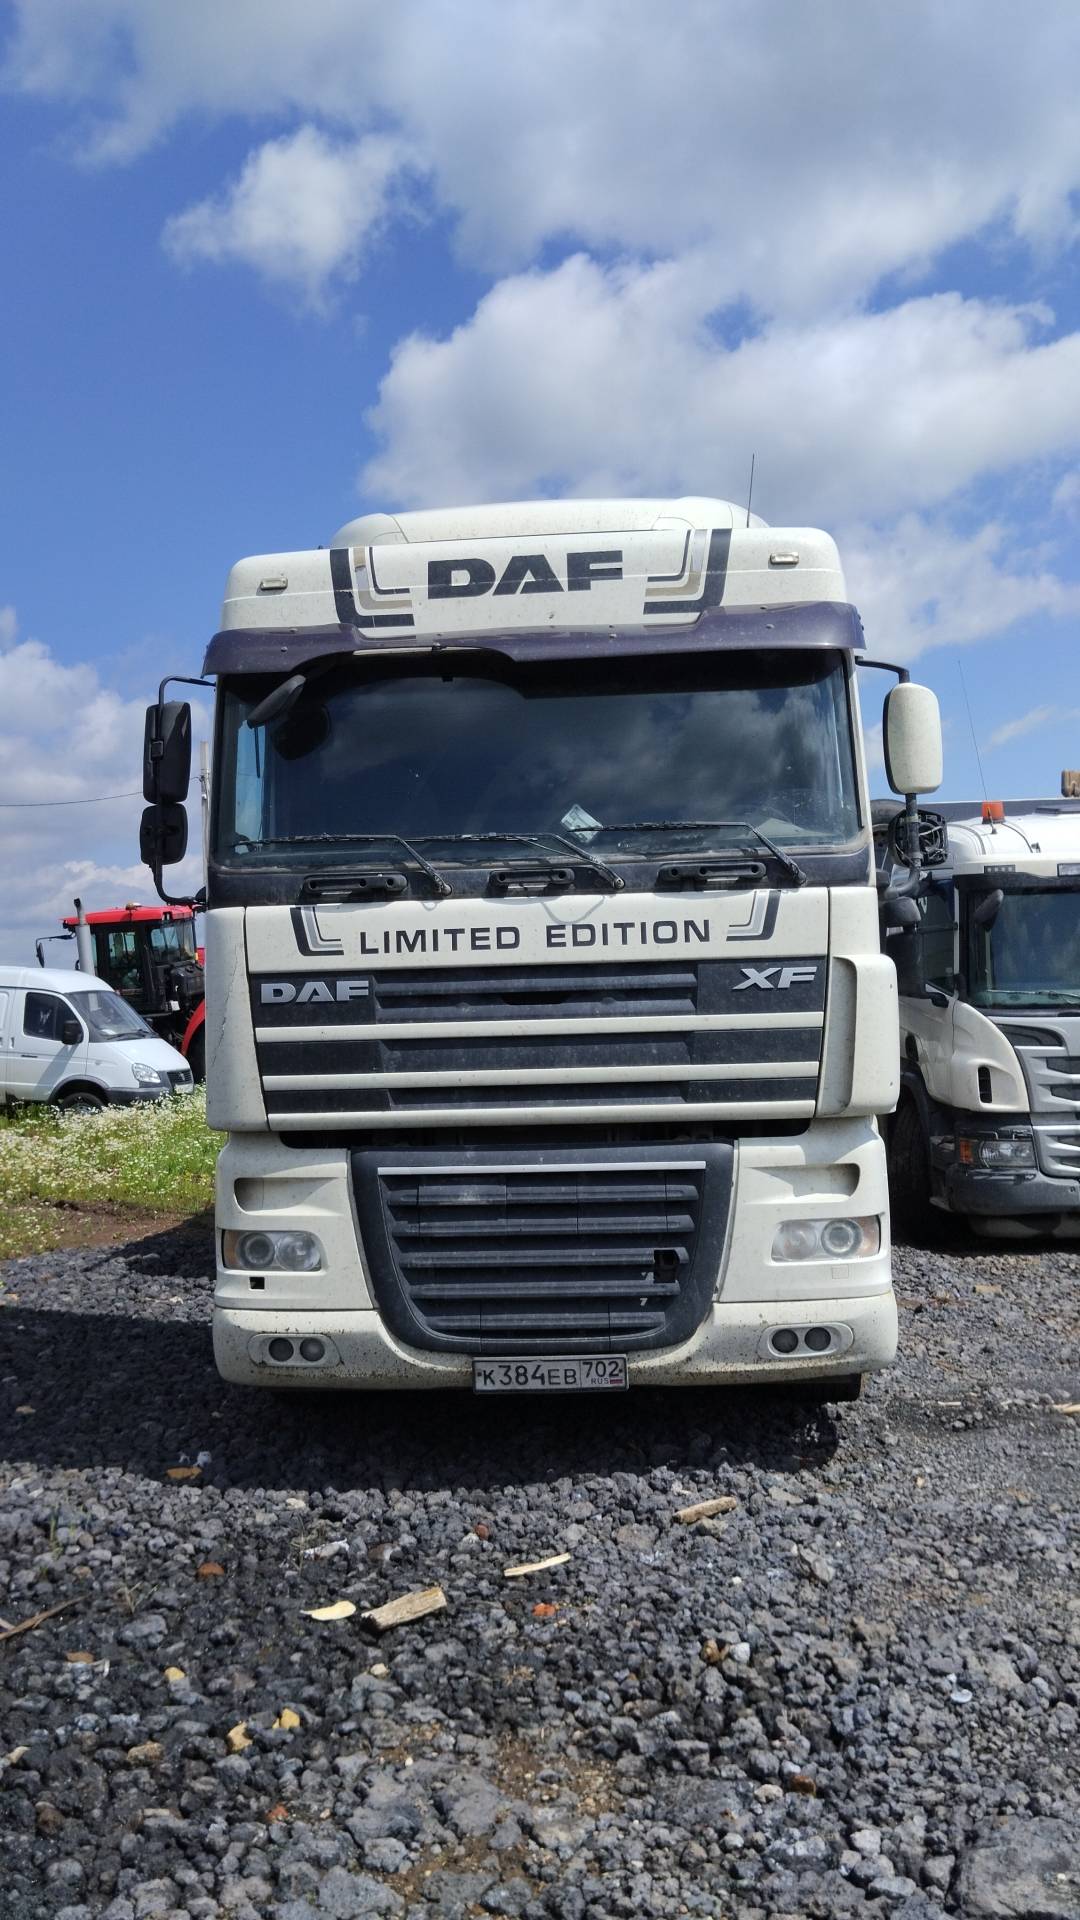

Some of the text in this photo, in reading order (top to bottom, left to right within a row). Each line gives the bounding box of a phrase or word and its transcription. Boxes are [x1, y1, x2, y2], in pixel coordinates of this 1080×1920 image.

[427, 550, 623, 600] DAF
[359, 919, 711, 955] LIMITED EDITION
[260, 980, 369, 1004] DAF
[732, 966, 818, 990] XF
